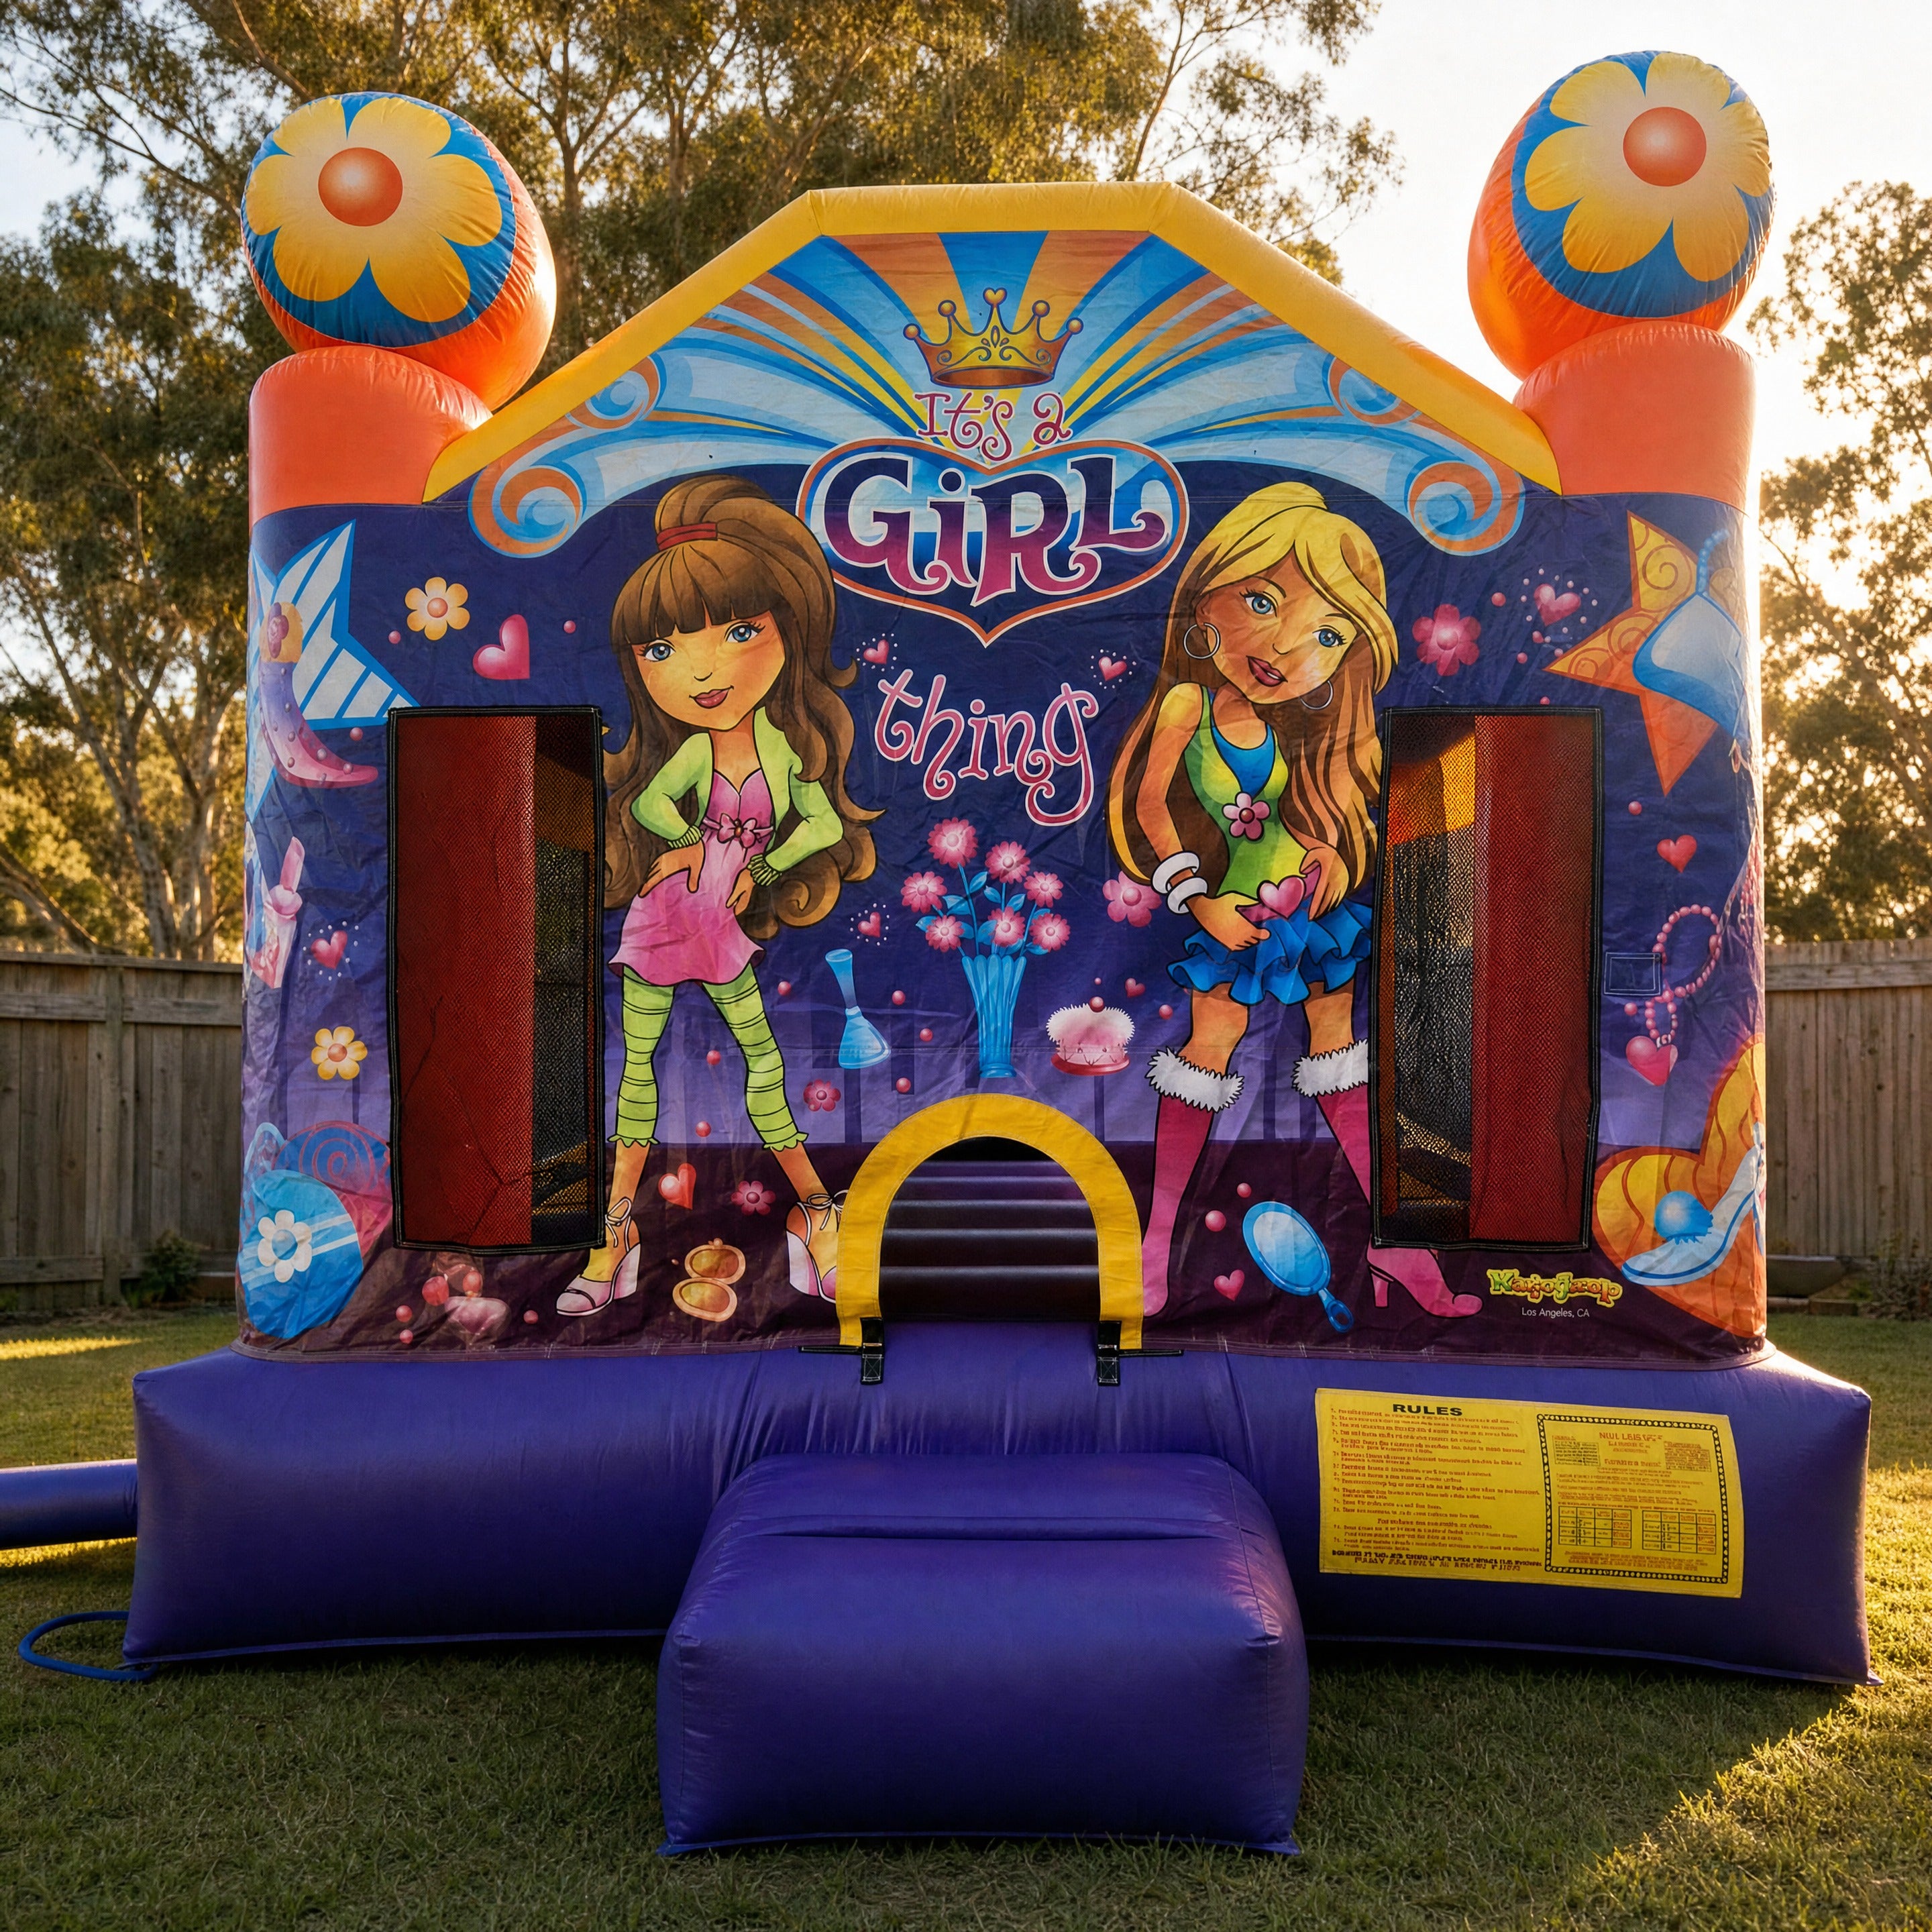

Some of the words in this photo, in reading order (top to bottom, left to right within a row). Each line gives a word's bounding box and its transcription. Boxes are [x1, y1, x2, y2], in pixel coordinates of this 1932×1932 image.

[914, 391, 1014, 462] It's
[1033, 392, 1072, 445] a
[875, 669, 1099, 826] thing
[1521, 1307, 1537, 1317] Los
[1540, 1307, 1575, 1319] Angeles,
[1577, 1309, 1590, 1318] CA
[1393, 1403, 1463, 1417] RULES
